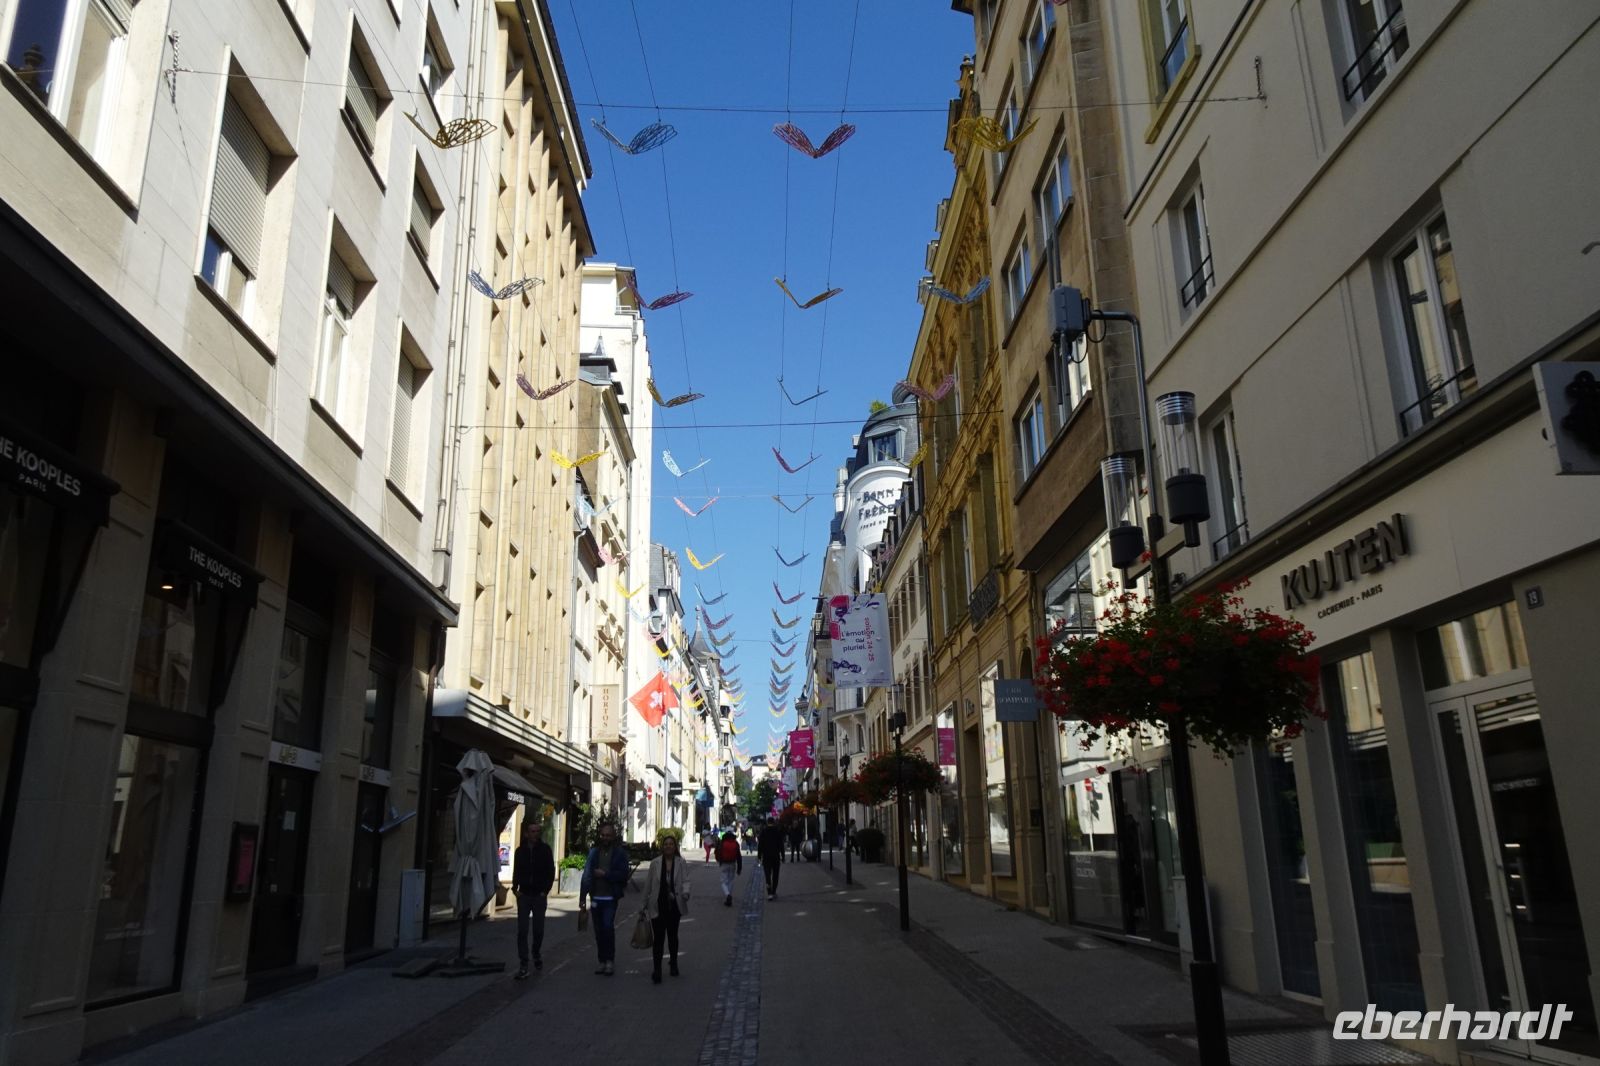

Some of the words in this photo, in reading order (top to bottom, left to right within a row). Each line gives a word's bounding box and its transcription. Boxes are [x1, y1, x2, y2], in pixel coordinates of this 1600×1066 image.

[16, 445, 81, 496] KOOPLES
[18, 472, 47, 492] PARIS
[858, 504, 894, 520] FRÈRE
[189, 545, 206, 567] THE
[206, 556, 242, 588] KOOPLES
[1280, 512, 1409, 610] KUJTEN
[1317, 596, 1355, 619] CACHEMIRE
[1361, 584, 1383, 600] PARIS
